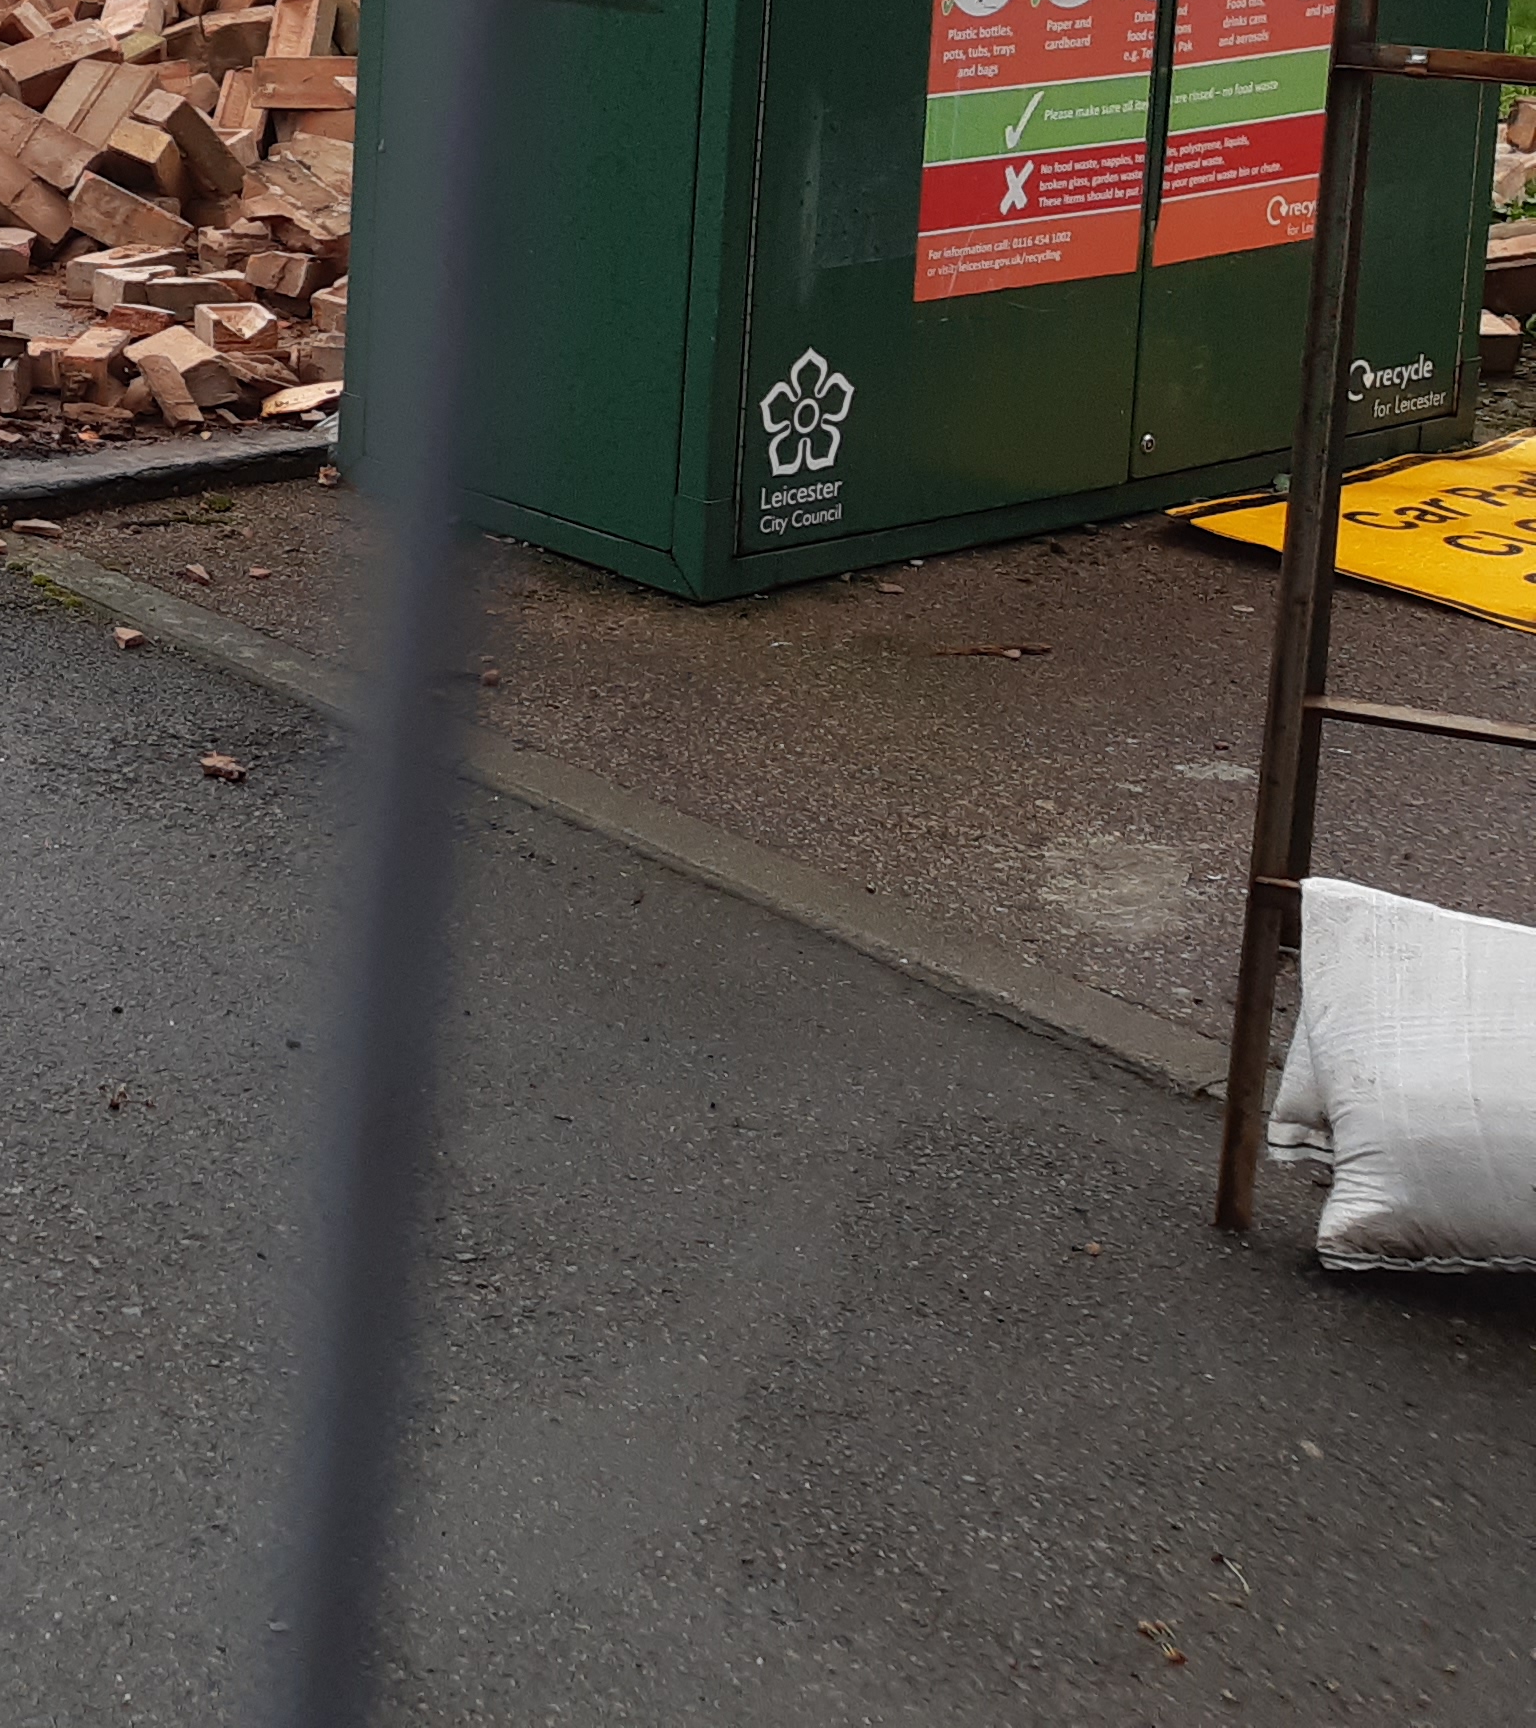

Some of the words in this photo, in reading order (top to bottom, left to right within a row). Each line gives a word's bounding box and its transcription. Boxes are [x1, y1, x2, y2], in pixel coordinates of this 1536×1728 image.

[1305, 4, 1321, 17] and
[1322, 4, 1336, 18] jar
[1046, 19, 1073, 33] Paper
[1074, 16, 1092, 29] and
[1223, 16, 1248, 29] drinks
[1249, 13, 1268, 24] cans
[948, 26, 978, 41] Plastic
[979, 25, 1013, 39] bottles,
[1127, 29, 1147, 41] food
[1218, 33, 1234, 47] and
[1236, 30, 1270, 45] aerosols
[1045, 34, 1091, 50] cardboard
[1178, 40, 1193, 53] Pak
[943, 48, 966, 63] pots,
[968, 45, 991, 58] tubs,
[993, 44, 1016, 57] trays
[957, 64, 975, 78] and
[977, 63, 999, 78] bags
[1044, 107, 1074, 121] Please
[1075, 104, 1100, 118] make
[1101, 102, 1121, 116] sure
[1189, 87, 1214, 103] rinsed
[1222, 88, 1233, 98] no
[1234, 81, 1254, 96] food
[1255, 80, 1278, 93] waste
[1039, 178, 1068, 191] broken
[1091, 172, 1119, 187] garden
[1174, 157, 1201, 174] general
[1041, 164, 1053, 174] No
[1054, 160, 1073, 172] food
[1038, 196, 1062, 208] These
[1063, 192, 1085, 205] items
[1087, 187, 1113, 202] should
[1114, 186, 1125, 197] be
[1125, 186, 1139, 199] put
[1171, 176, 1188, 190] your
[1188, 170, 1216, 188] general
[1216, 169, 1238, 181] waste
[1238, 166, 1250, 177] bin
[1251, 165, 1260, 175] or
[1289, 200, 1317, 217] recy
[1287, 223, 1299, 236] for
[928, 249, 942, 261] For
[944, 242, 992, 258] information
[994, 239, 1011, 252] call:
[1012, 236, 1033, 248] 0116
[1034, 234, 1050, 246] 454
[1051, 231, 1072, 244] 1002
[927, 267, 936, 277] or
[958, 249, 1062, 272] leicester.gov.uk/recycling
[1375, 353, 1433, 390] recycle
[1374, 399, 1390, 418] for
[1394, 391, 1447, 414] Leicester
[761, 480, 843, 510] Leicester
[760, 515, 788, 536] City
[792, 503, 842, 527] Council
[1341, 497, 1473, 531] Car
